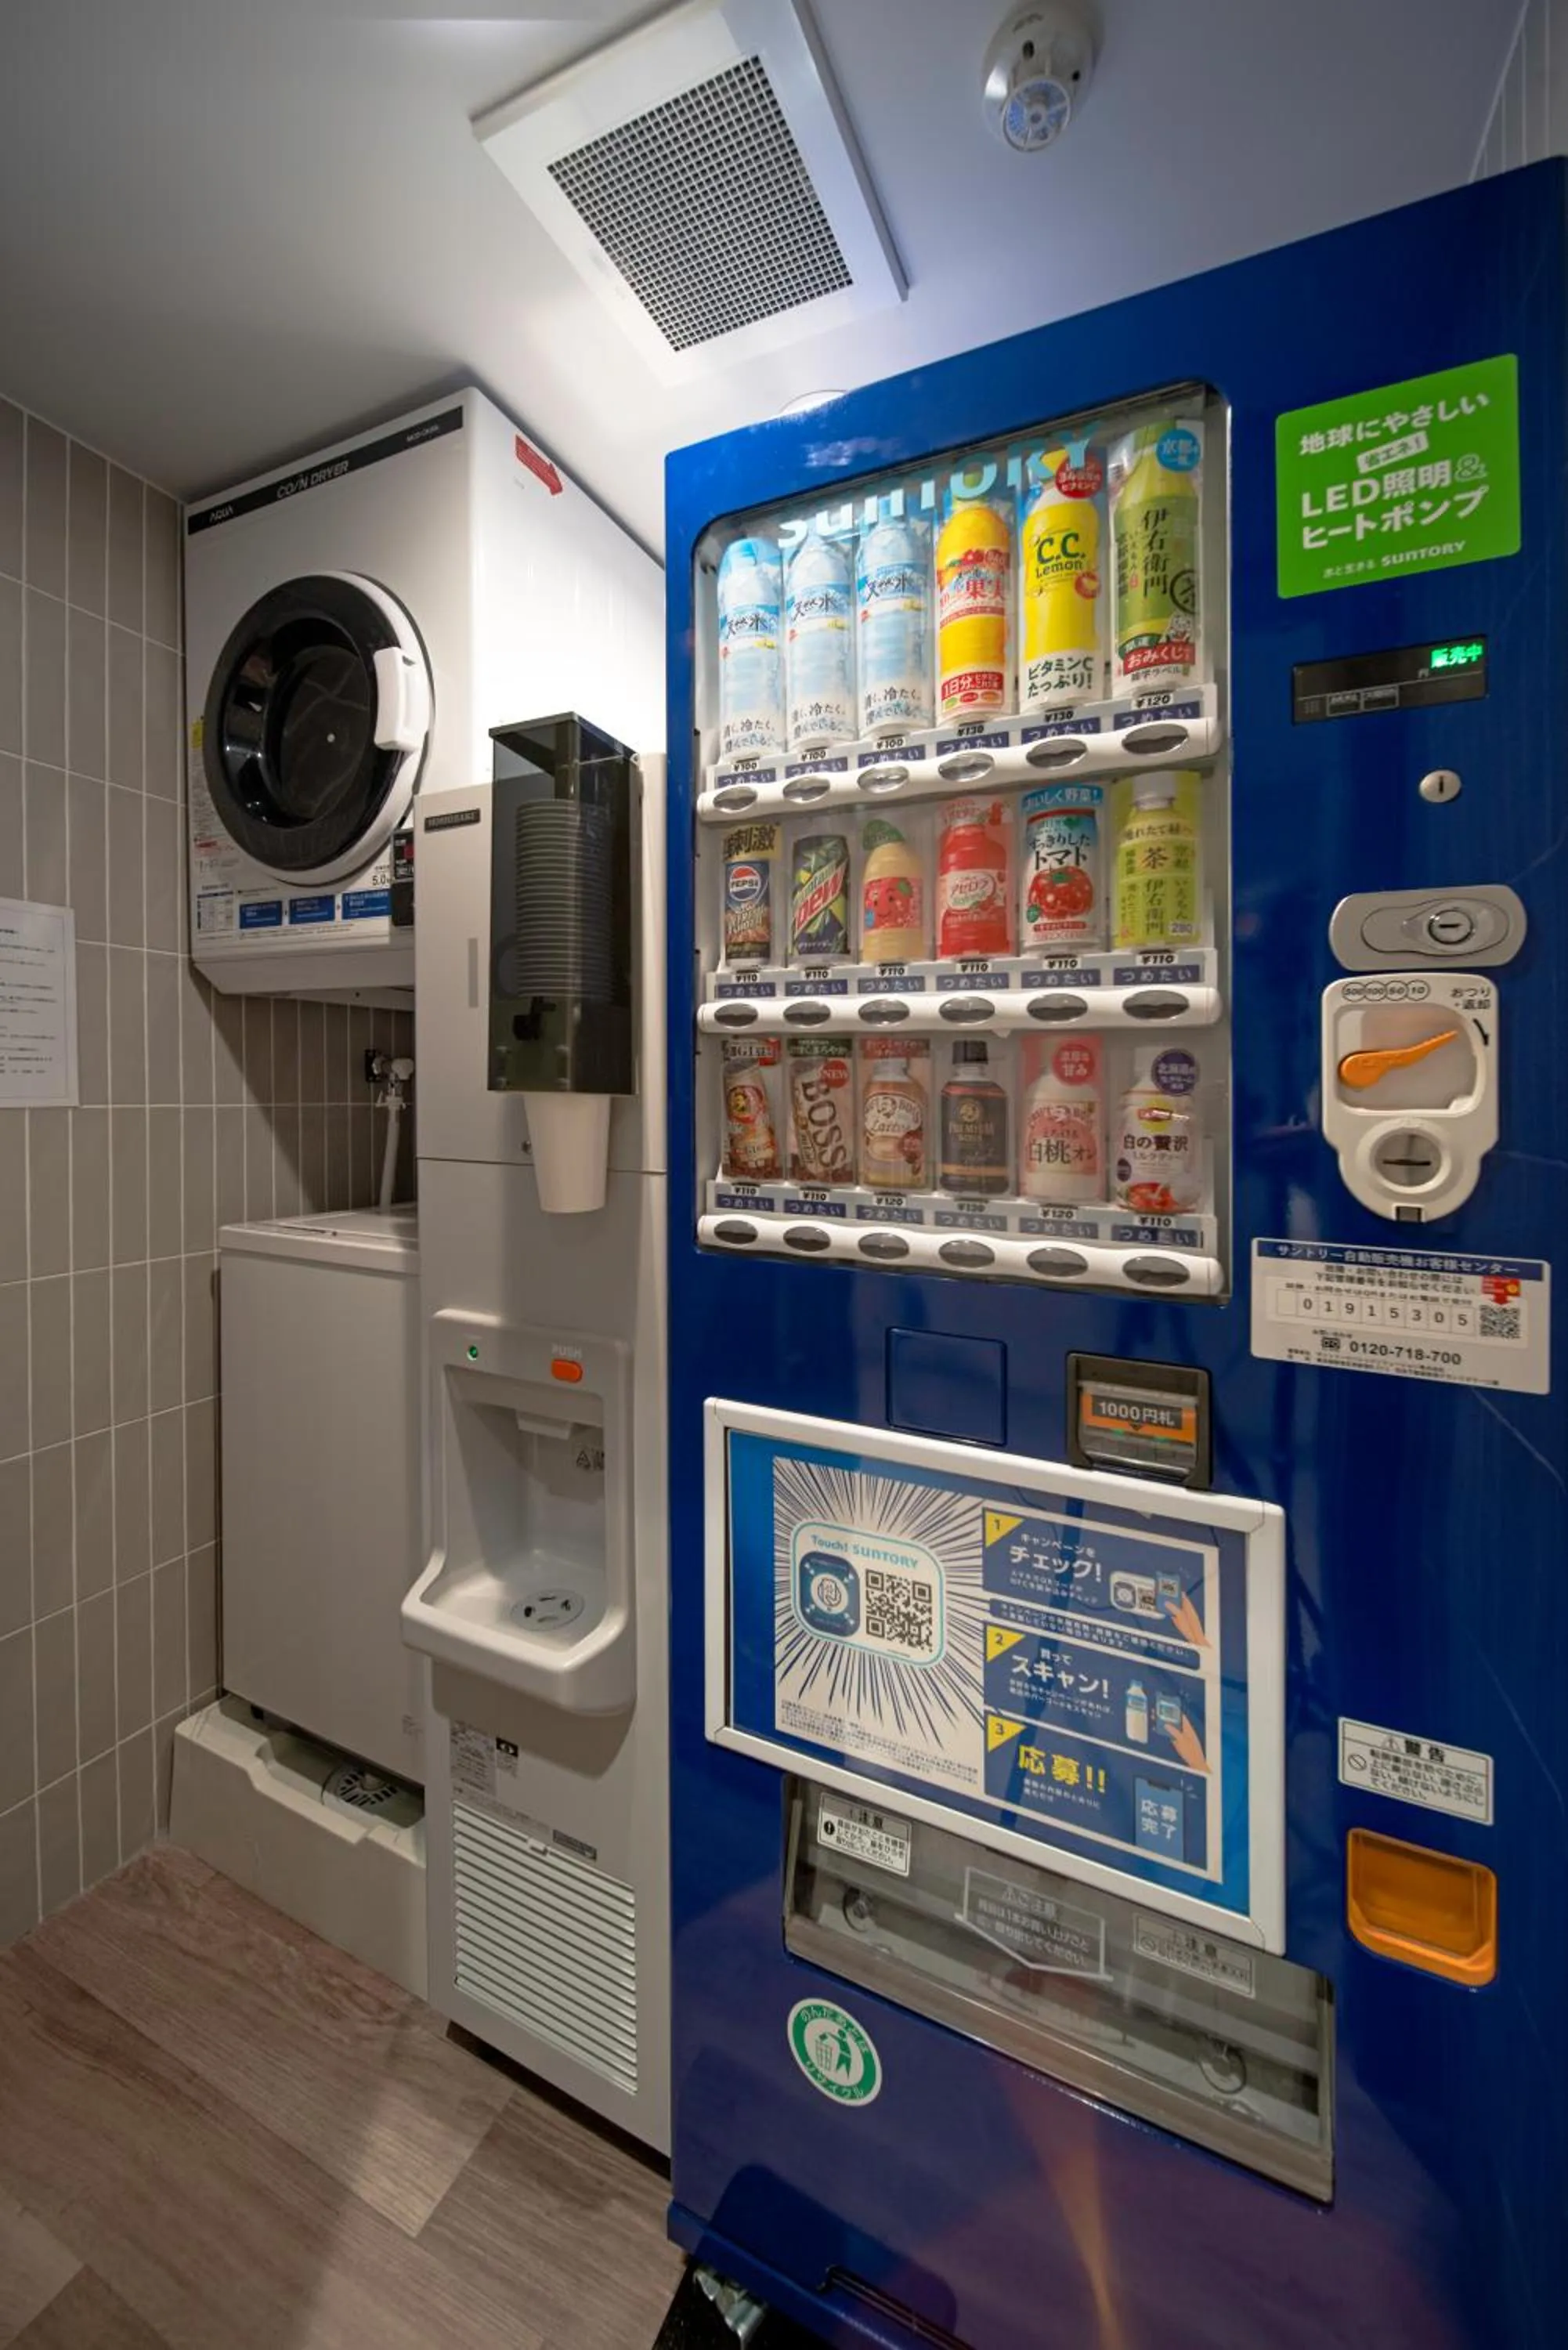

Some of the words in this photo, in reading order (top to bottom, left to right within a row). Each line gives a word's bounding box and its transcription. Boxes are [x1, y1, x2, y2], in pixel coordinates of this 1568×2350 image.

[1299, 393, 1490, 455] 地球にやさしい
[312, 460, 349, 486] DRYER
[1302, 454, 1487, 518] LED照明&
[1302, 486, 1489, 549] ヒートポンプ
[1037, 533, 1086, 564] C.C.
[1143, 507, 1170, 598] 伊右衛門
[1382, 540, 1466, 566] SUNTORY
[1035, 559, 1083, 578] Lemon
[1431, 644, 1483, 668] 販売中
[1028, 656, 1093, 681] ビタミンC
[1028, 673, 1092, 698] たっぷり!
[1136, 694, 1171, 707] ¥120
[1045, 709, 1074, 721] ¥130
[1122, 707, 1194, 727] つめたい
[957, 724, 985, 736] ¥130
[1028, 724, 1094, 742] つめたい
[876, 739, 904, 750] ¥100
[943, 734, 1004, 754] つめたい
[801, 750, 826, 761] ¥100
[864, 750, 919, 766] つめたい
[734, 762, 757, 772] ¥100
[1029, 833, 1090, 849] すっきりした
[1035, 846, 1087, 870] トマト
[1142, 847, 1169, 870] 茶
[730, 878, 759, 889] PEPSI
[1048, 958, 1078, 969] ¥110
[1142, 954, 1174, 965] ¥110
[804, 970, 828, 979] ¥110
[879, 966, 905, 976] ¥110
[960, 963, 988, 973] ¥110
[1122, 967, 1192, 982] つめたい
[735, 974, 757, 982] ¥110
[865, 978, 919, 990] つめたい
[943, 976, 1003, 989] つめたい
[1028, 971, 1093, 985] つめたい
[722, 985, 771, 996] つめたい
[792, 982, 843, 995] つめたい
[1451, 987, 1490, 999] おつり
[823, 1068, 848, 1080] NEW
[802, 1080, 847, 1169] BOSS
[1124, 1133, 1188, 1152] 白の贅沢
[735, 1187, 756, 1195] ¥110
[804, 1191, 826, 1201] ¥110
[721, 1197, 769, 1209] つめたい
[789, 1201, 841, 1215] つめたい
[876, 1197, 903, 1206] ¥120
[862, 1208, 917, 1221] つめたい
[942, 1215, 1001, 1228] つめたい
[1042, 1209, 1074, 1220] ¥120
[1139, 1217, 1172, 1227] ¥110
[1028, 1221, 1091, 1236] つめたい
[1120, 1229, 1190, 1244] つめたい
[1276, 1244, 1519, 1275] サントリー自動販売機お客様センター
[551, 1344, 582, 1359] PUSH
[1349, 1342, 1462, 1365] 0120-718-700
[1099, 1401, 1175, 1426] 1000円札
[811, 1535, 848, 1553] Touch!
[852, 1543, 918, 1568] SUNTORY
[1021, 1533, 1096, 1557] キャンペーンを
[1010, 1545, 1101, 1582] チェック!
[995, 1633, 1003, 1645] 2
[1040, 1647, 1073, 1665] 買って
[1011, 1654, 1108, 1698] スキャン!
[995, 1723, 1003, 1735] 3
[1018, 1744, 1105, 1793] 応募!!
[1140, 1799, 1177, 1822] 応募
[1141, 1818, 1177, 1839] 完了
